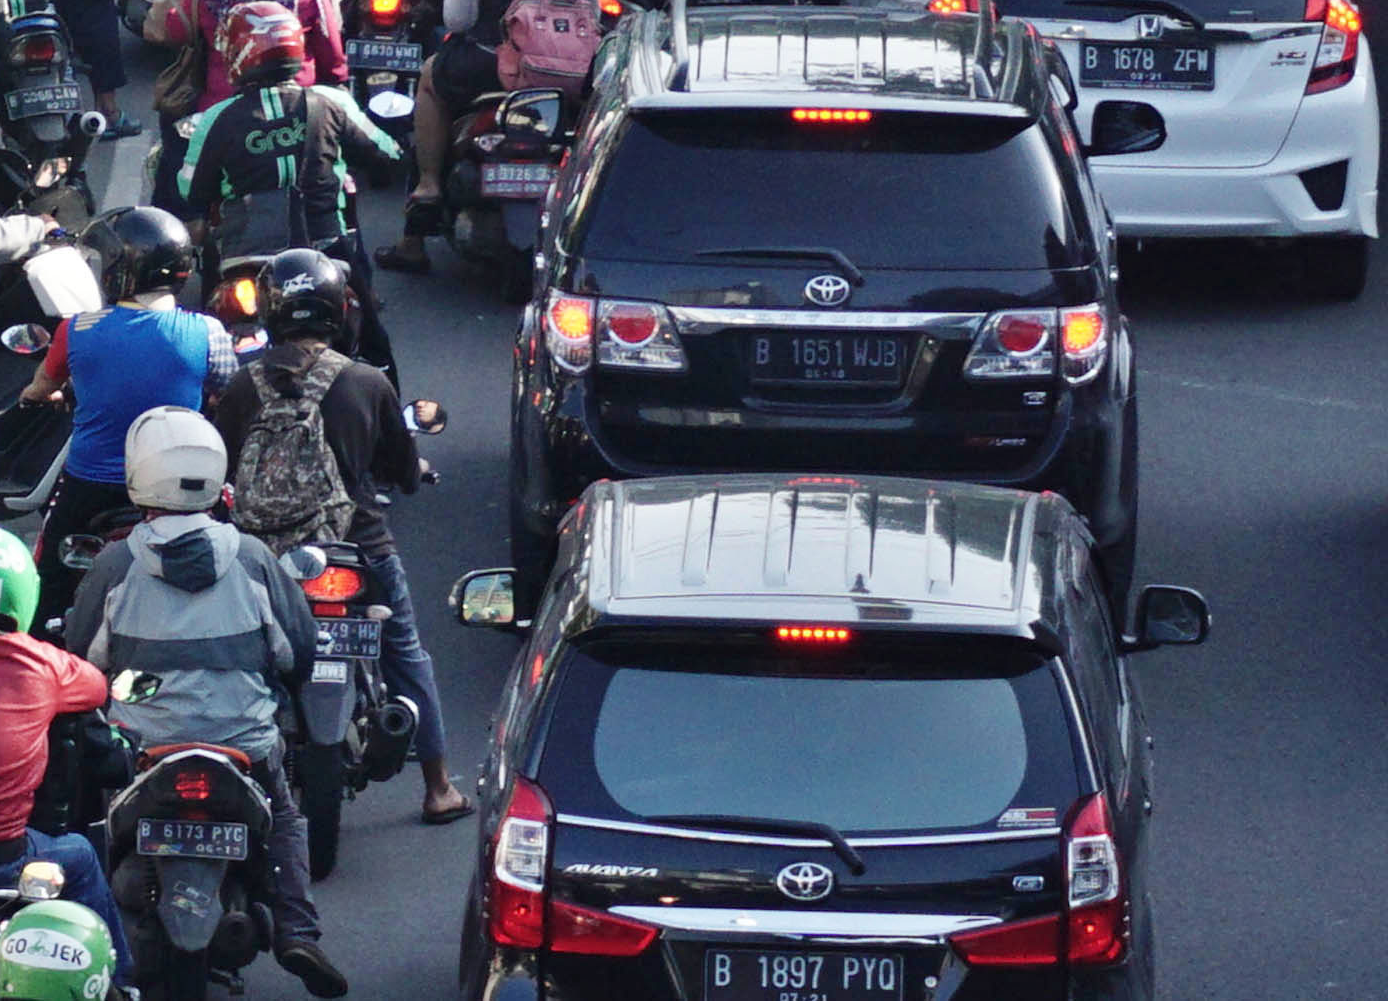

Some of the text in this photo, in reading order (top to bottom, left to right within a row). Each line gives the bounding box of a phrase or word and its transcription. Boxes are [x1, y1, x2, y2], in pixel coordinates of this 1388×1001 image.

[1084, 45, 1210, 73] B 1678 ZFW
[755, 337, 897, 367] B 1651 WJB
[140, 823, 151, 838] B
[162, 825, 204, 840] 6173
[563, 863, 660, 878] AVANZA
[4, 935, 84, 967] GO JEK
[715, 953, 896, 991] B 1897 PYQ
